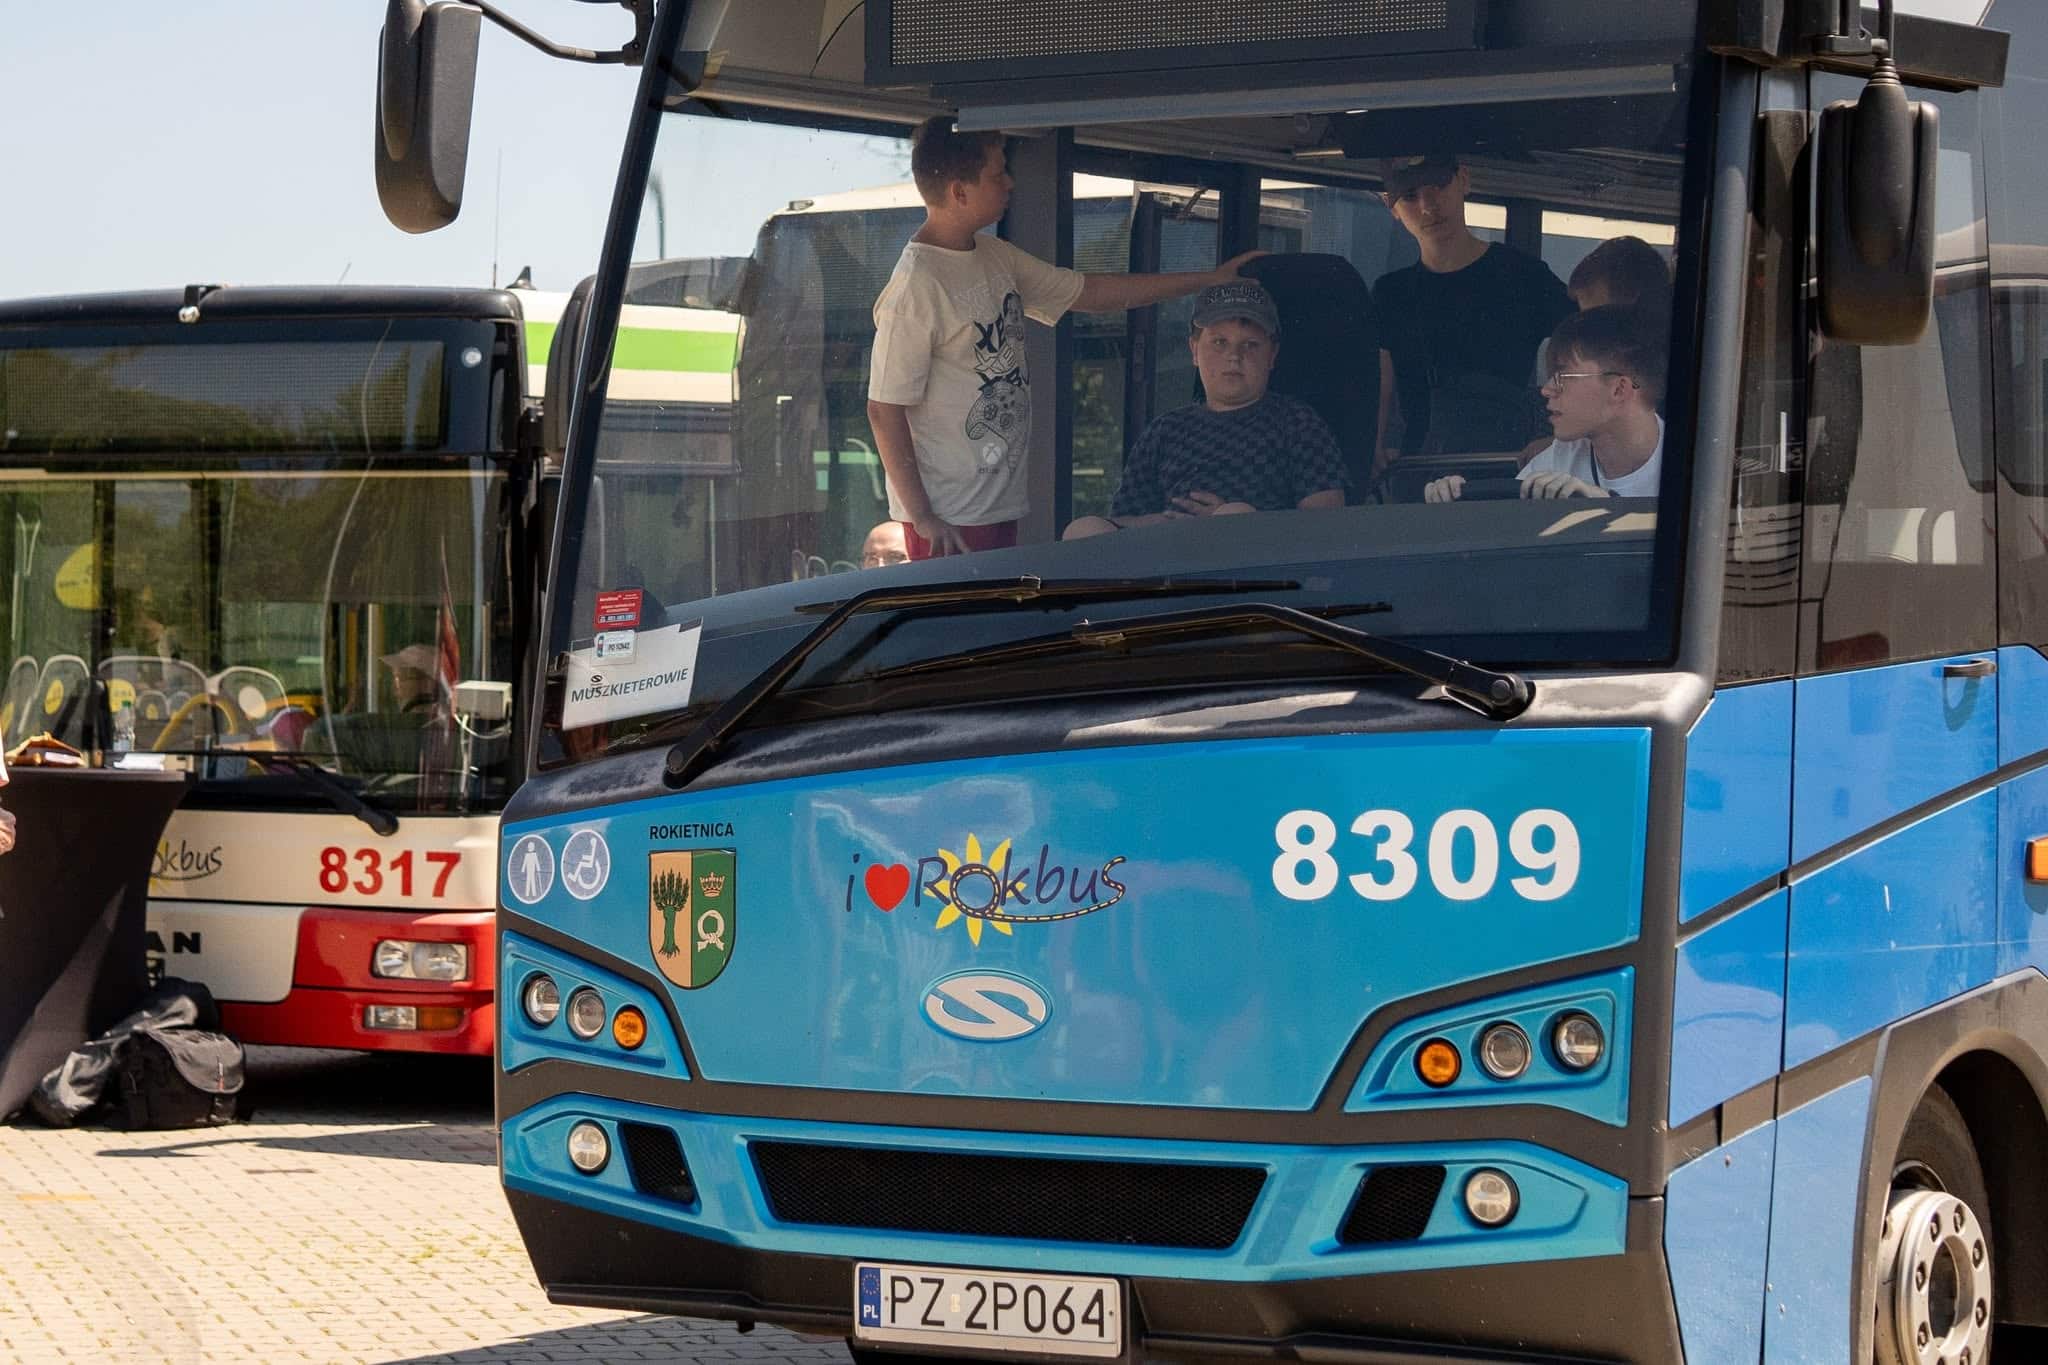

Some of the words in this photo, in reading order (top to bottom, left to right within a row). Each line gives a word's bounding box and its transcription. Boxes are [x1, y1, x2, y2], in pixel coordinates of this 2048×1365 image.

[571, 668, 688, 703] MUSZKIETEROWIE
[650, 822, 734, 840] ROKIETNICA
[319, 847, 462, 898] 8317
[1272, 809, 1581, 901] 8309
[914, 844, 1127, 923] Rokbus
[145, 931, 201, 954] AN
[863, 1304, 879, 1319] PL
[890, 1275, 945, 1327] PZ
[965, 1280, 1105, 1338] 2P064
